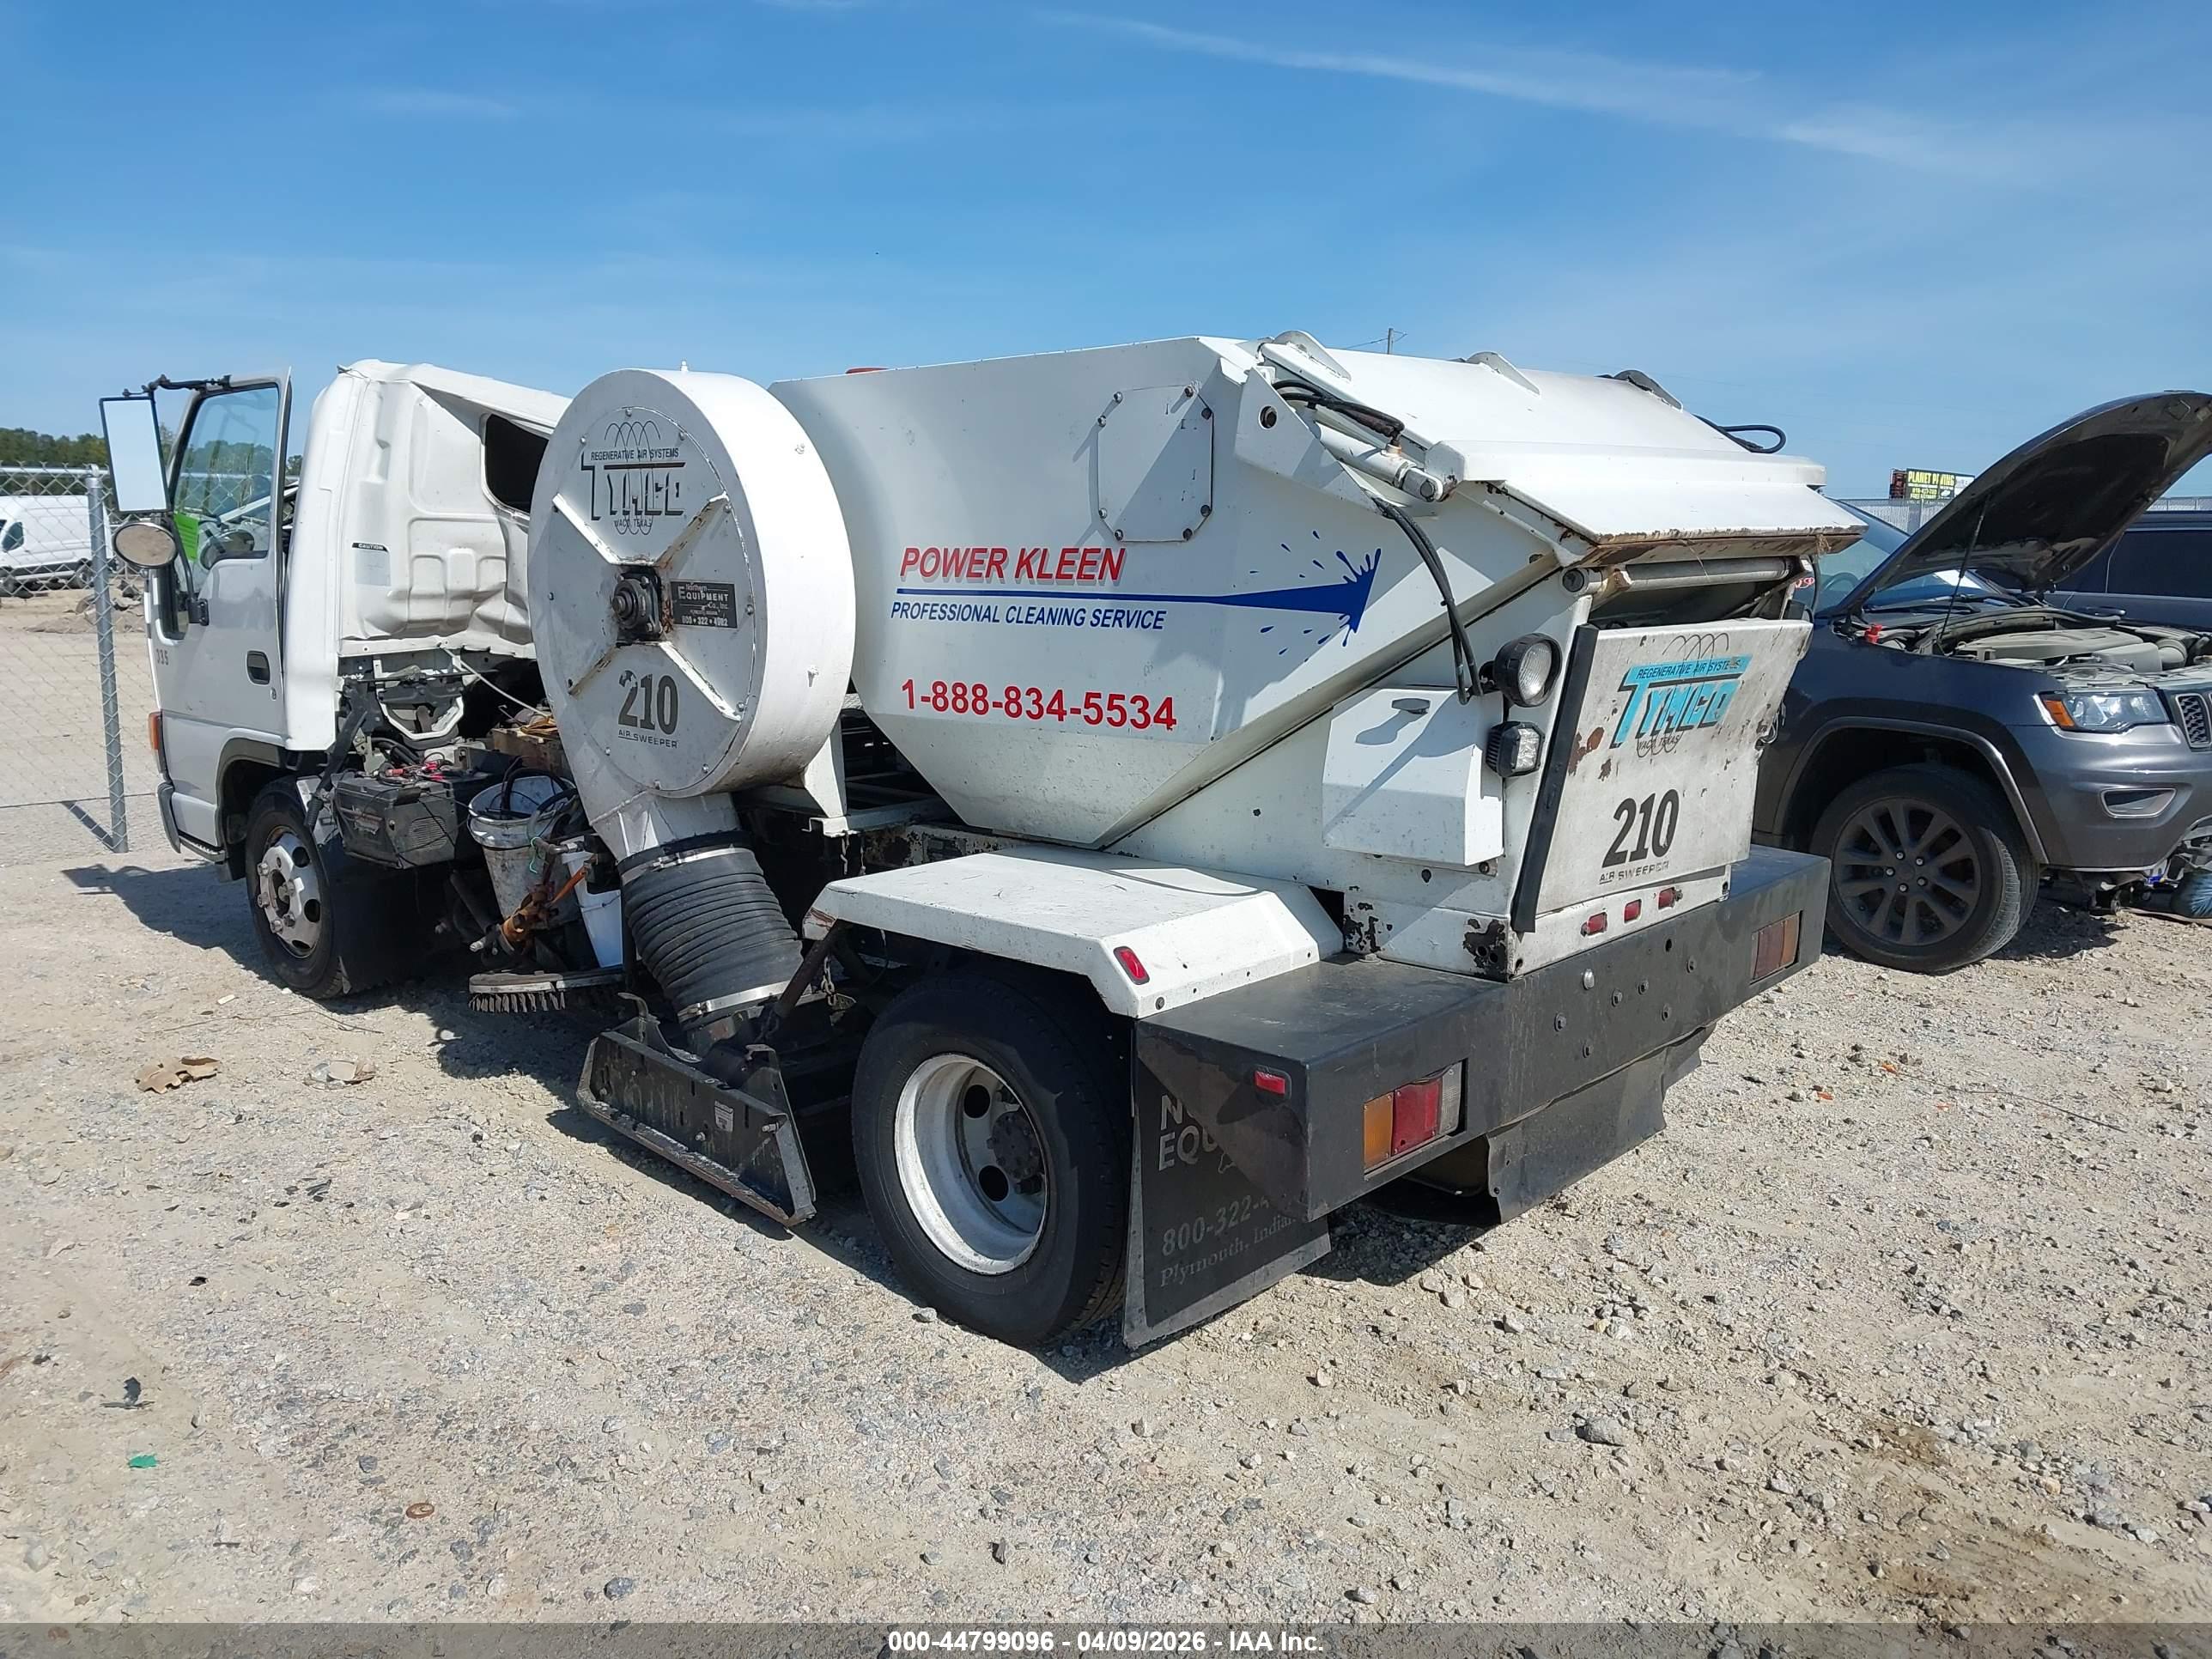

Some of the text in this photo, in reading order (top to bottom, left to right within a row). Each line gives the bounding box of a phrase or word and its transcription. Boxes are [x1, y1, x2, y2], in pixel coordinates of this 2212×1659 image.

[637, 448, 647, 459] AIR
[650, 447, 679, 459] SYSTEMS
[900, 547, 1127, 583] POWER KLEEN
[678, 586, 729, 601] EQUIPMENT
[890, 601, 1166, 629] PROFESSIONAL CLEANING SERVICE
[1693, 662, 1710, 674] AIR
[1709, 659, 1741, 672] SYSTES
[618, 670, 678, 735] 210
[902, 678, 1177, 730] 1-888-834-5534
[1609, 655, 1753, 750] TYMCO
[633, 733, 678, 749] SWEEPER
[1601, 788, 1680, 868] 210
